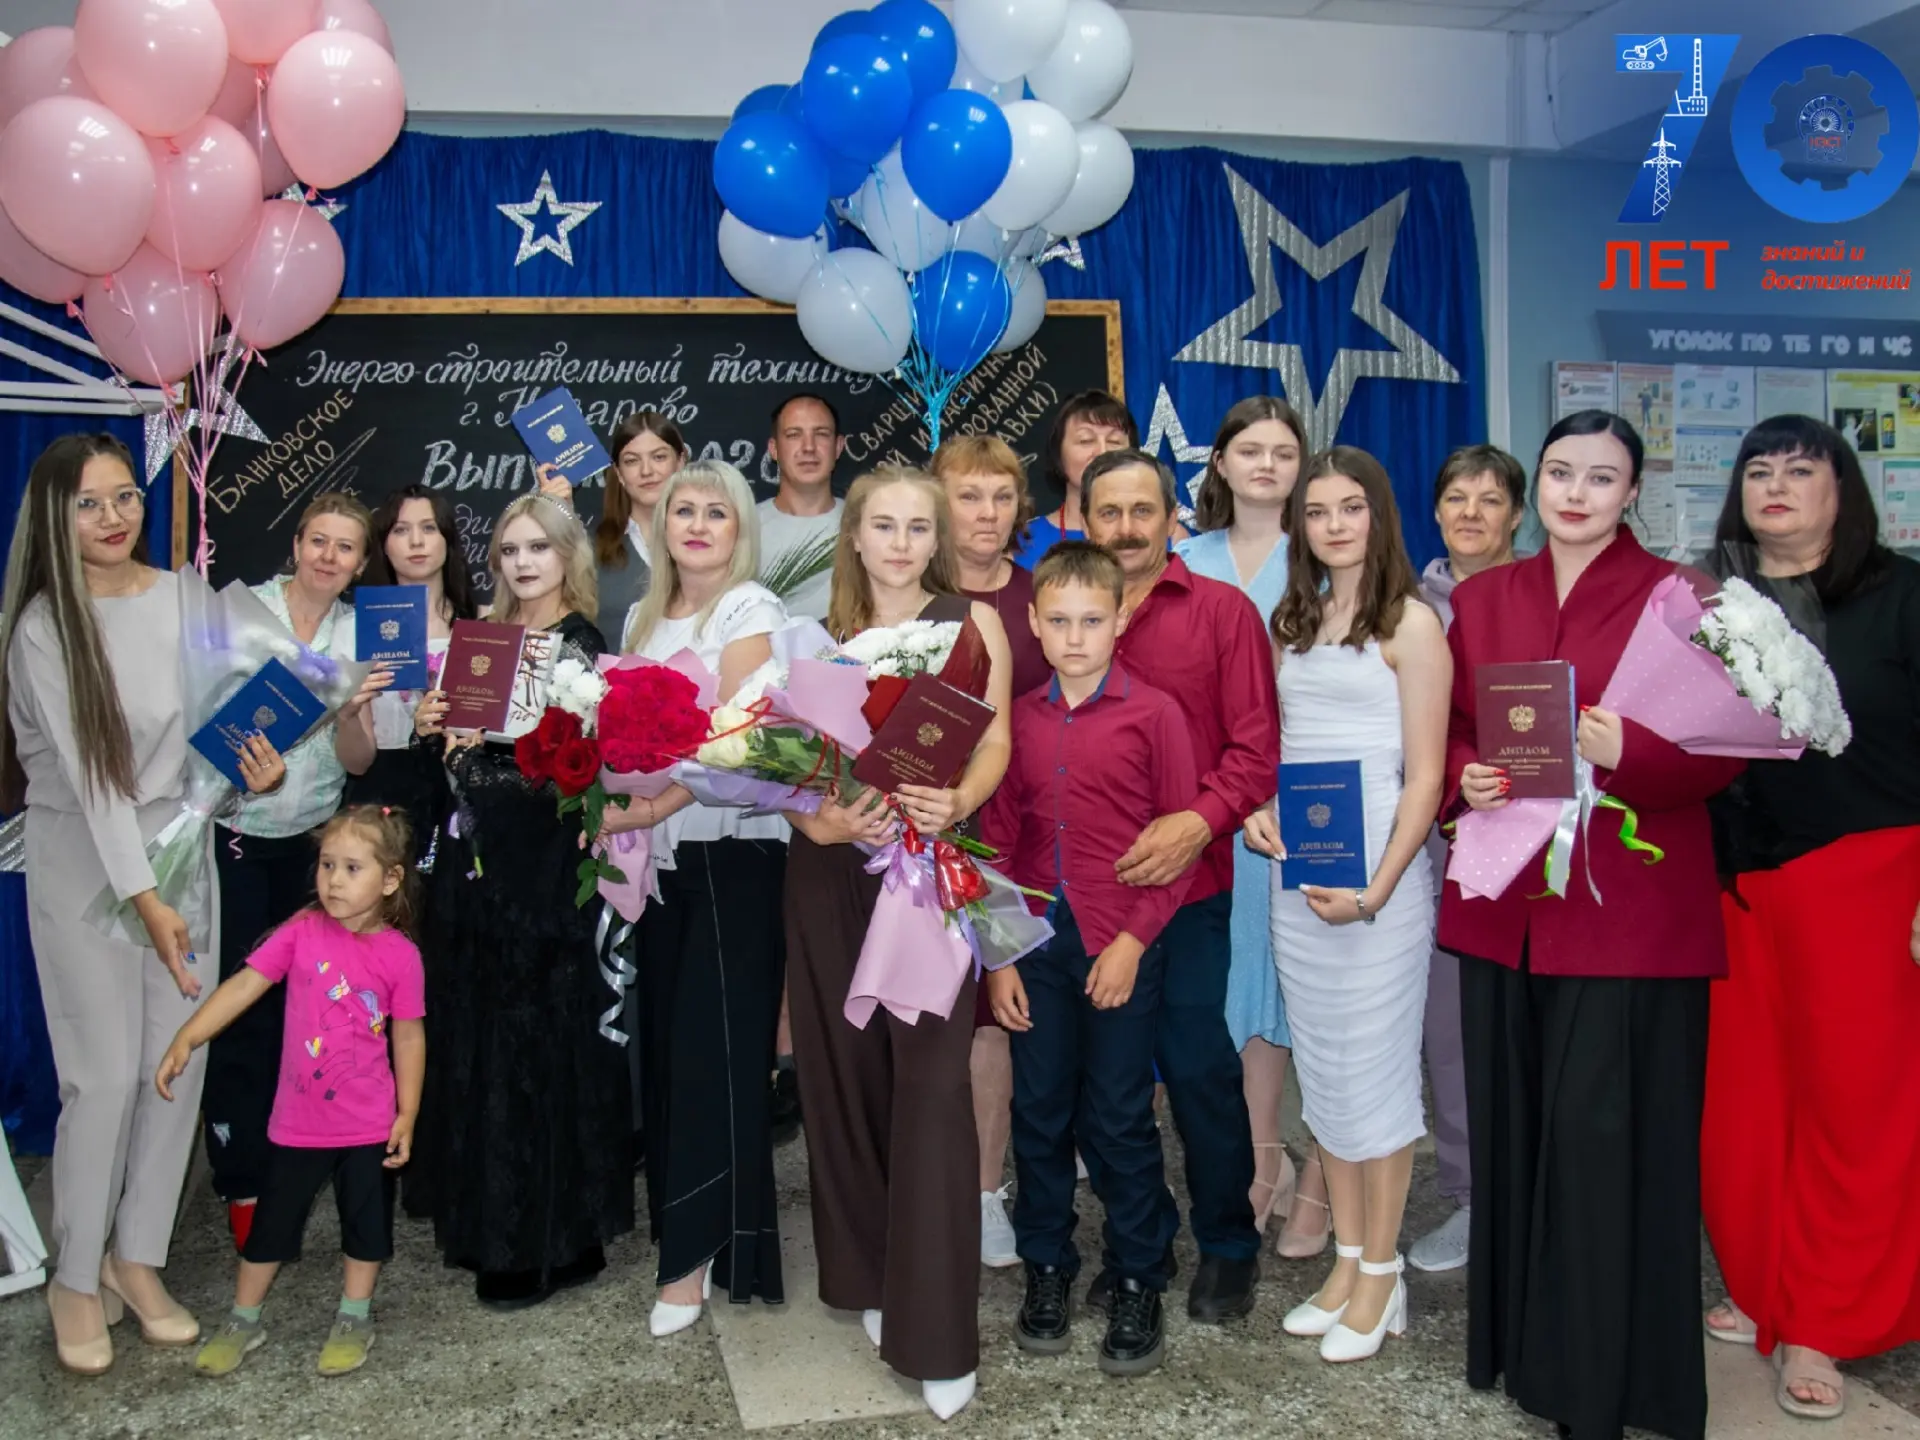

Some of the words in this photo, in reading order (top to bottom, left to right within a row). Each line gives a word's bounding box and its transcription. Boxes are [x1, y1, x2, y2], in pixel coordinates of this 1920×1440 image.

[1741, 333, 1772, 353] ПО
[1782, 334, 1811, 354] ТБ
[1821, 335, 1850, 355] ГО
[1858, 336, 1875, 355] И
[205, 389, 353, 513] БАНКОВСКОЕ
[278, 440, 335, 498] ДЕЛО
